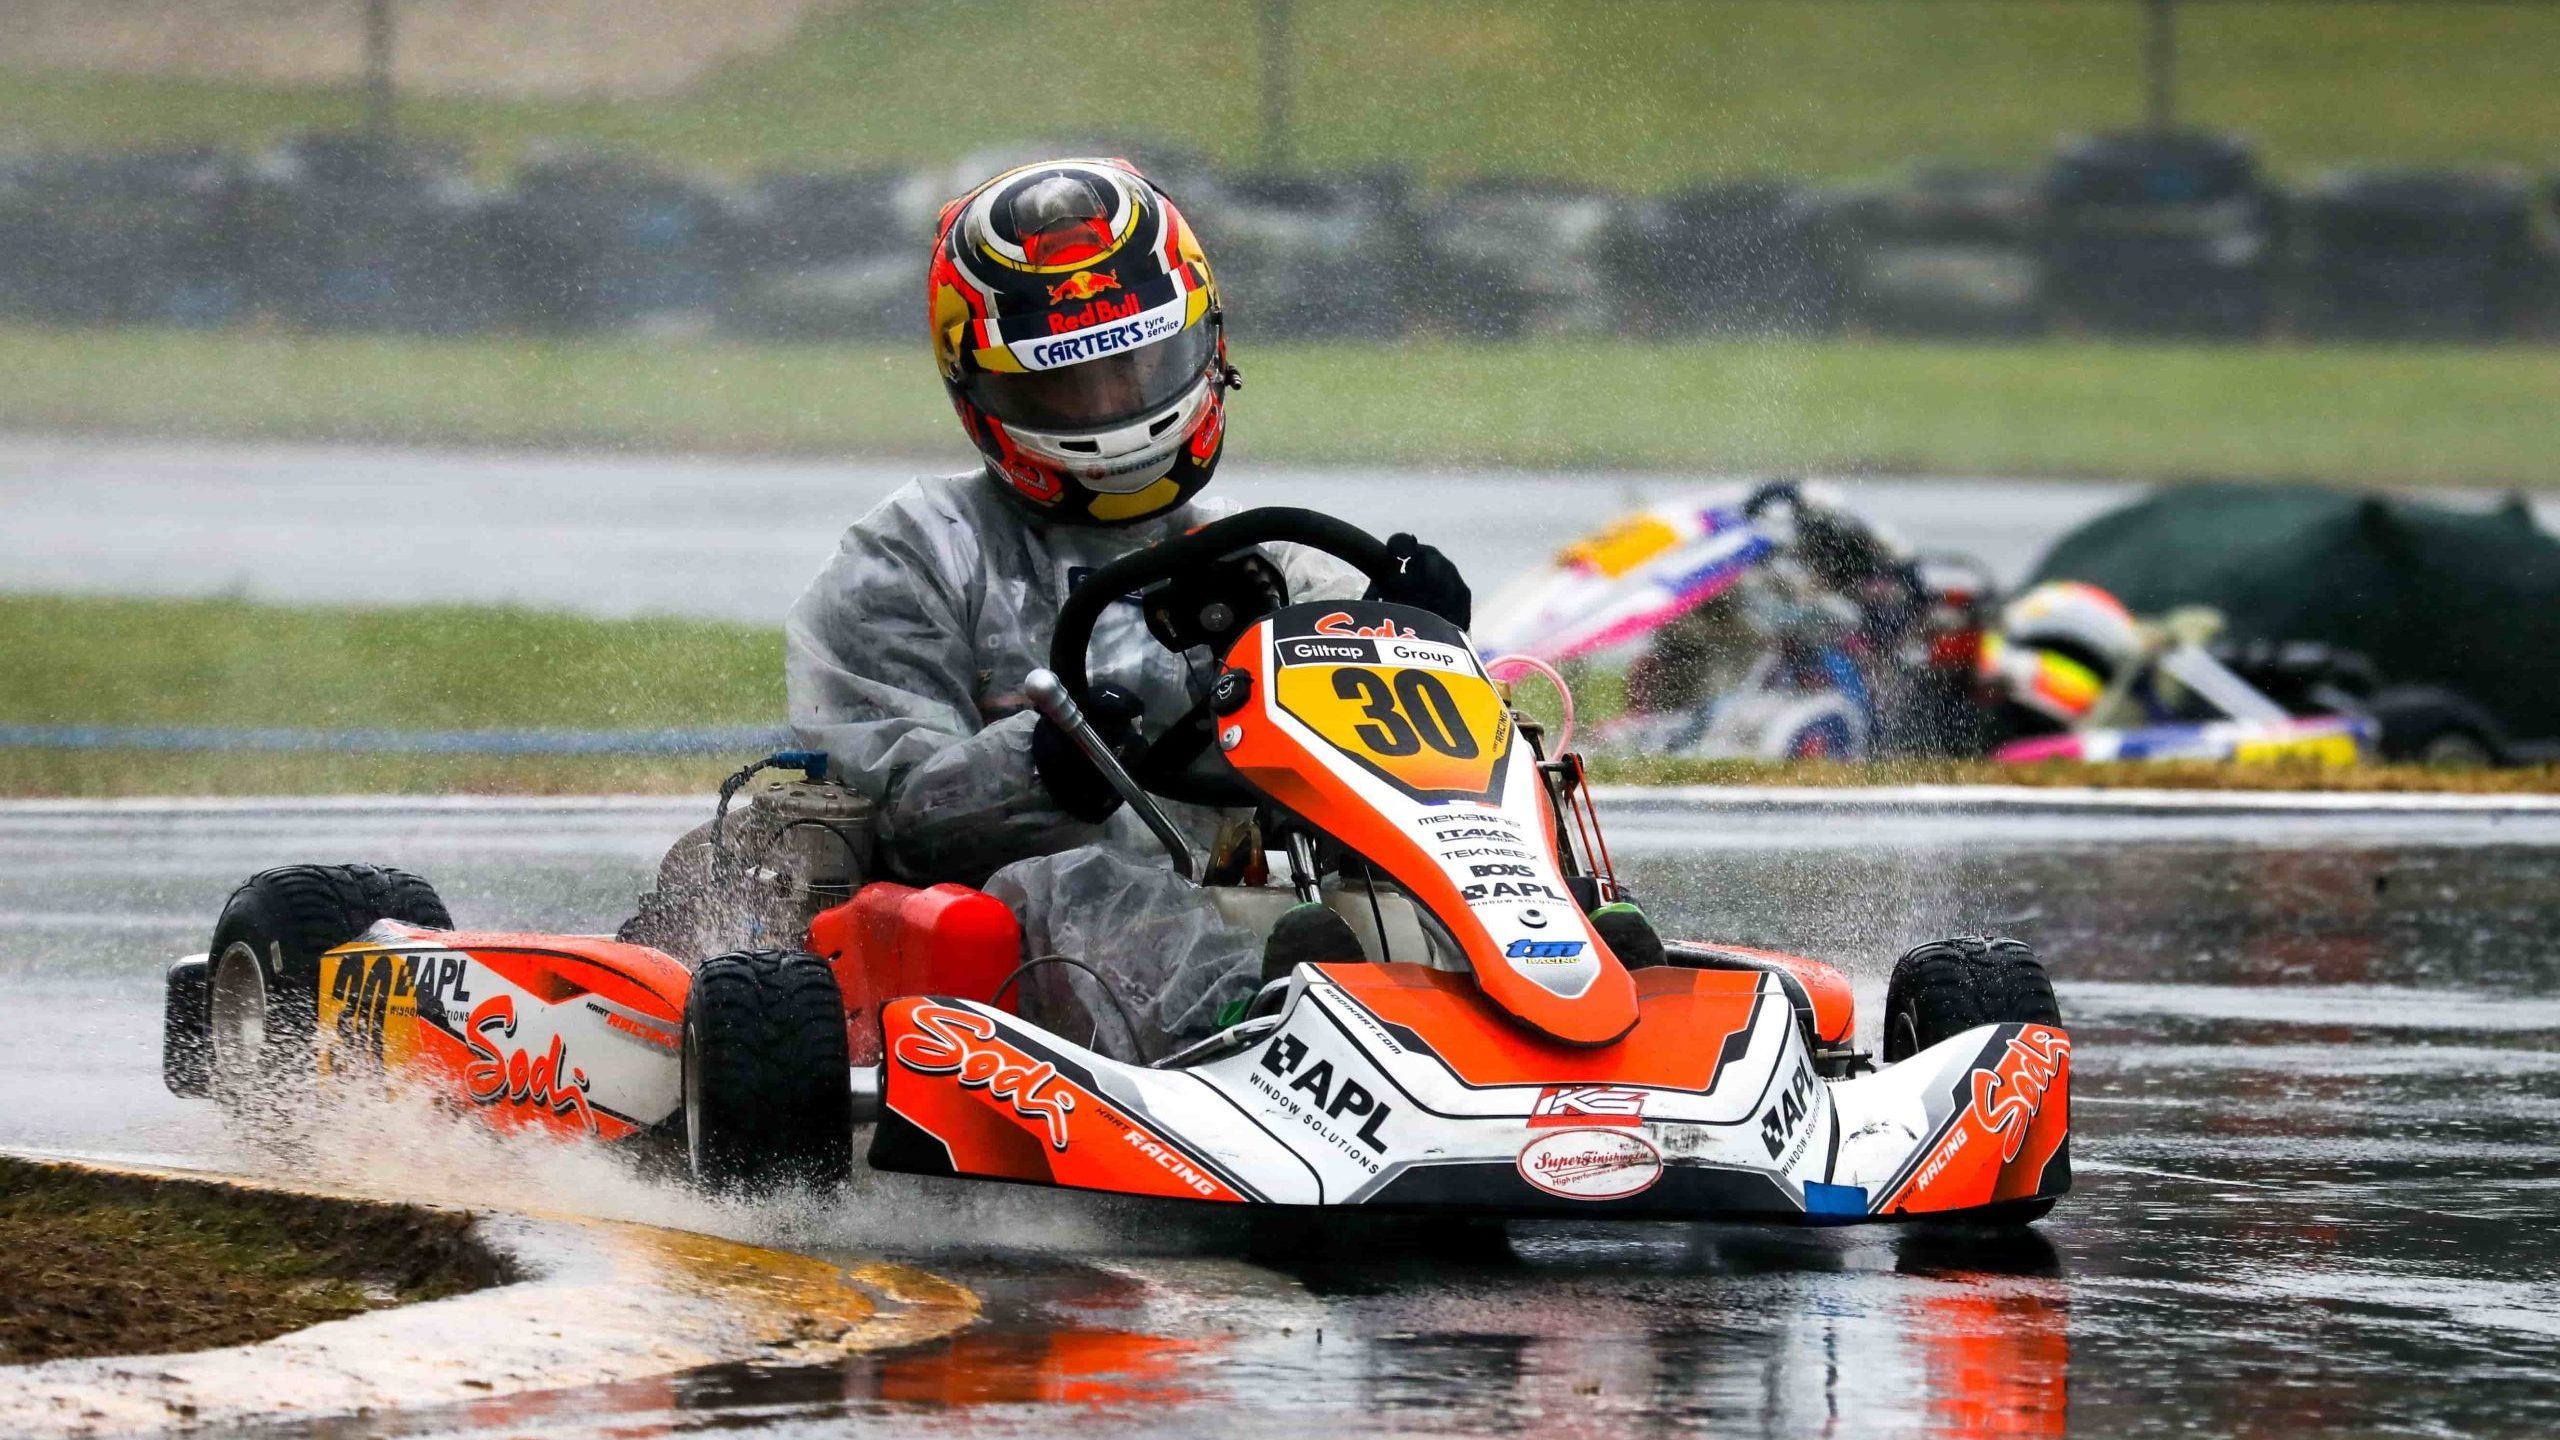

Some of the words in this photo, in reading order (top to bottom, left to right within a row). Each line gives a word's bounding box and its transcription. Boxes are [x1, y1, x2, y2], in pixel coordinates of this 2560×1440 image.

[1033, 321, 1144, 368] CARTER'S
[1144, 315, 1165, 330] tyre
[1147, 318, 1179, 339] service
[1294, 643, 1364, 659] Giltrap
[1393, 645, 1454, 666] Group
[1330, 667, 1480, 760] 30
[1435, 828, 1523, 842] ITAKA
[1440, 847, 1540, 862] TEKNEEX
[1493, 882, 1568, 902] APL
[416, 955, 470, 1003] APL
[390, 1005, 421, 1017] WINDO
[586, 1001, 610, 1018] KART
[463, 994, 598, 1135] Sodi
[895, 1005, 1076, 1150] Sodi
[1288, 1058, 1393, 1156] APL
[1780, 1055, 1815, 1141] APL
[1971, 1031, 2071, 1164] Sodi
[1250, 1072, 1301, 1116] WINDOW
[1303, 1114, 1380, 1176] SOLUTIONS
[1123, 1128, 1218, 1197] RACING
[1552, 1176, 1571, 1187] High
[1781, 1140, 1808, 1178] WINDOW
[1917, 1126, 1969, 1193] RACING
